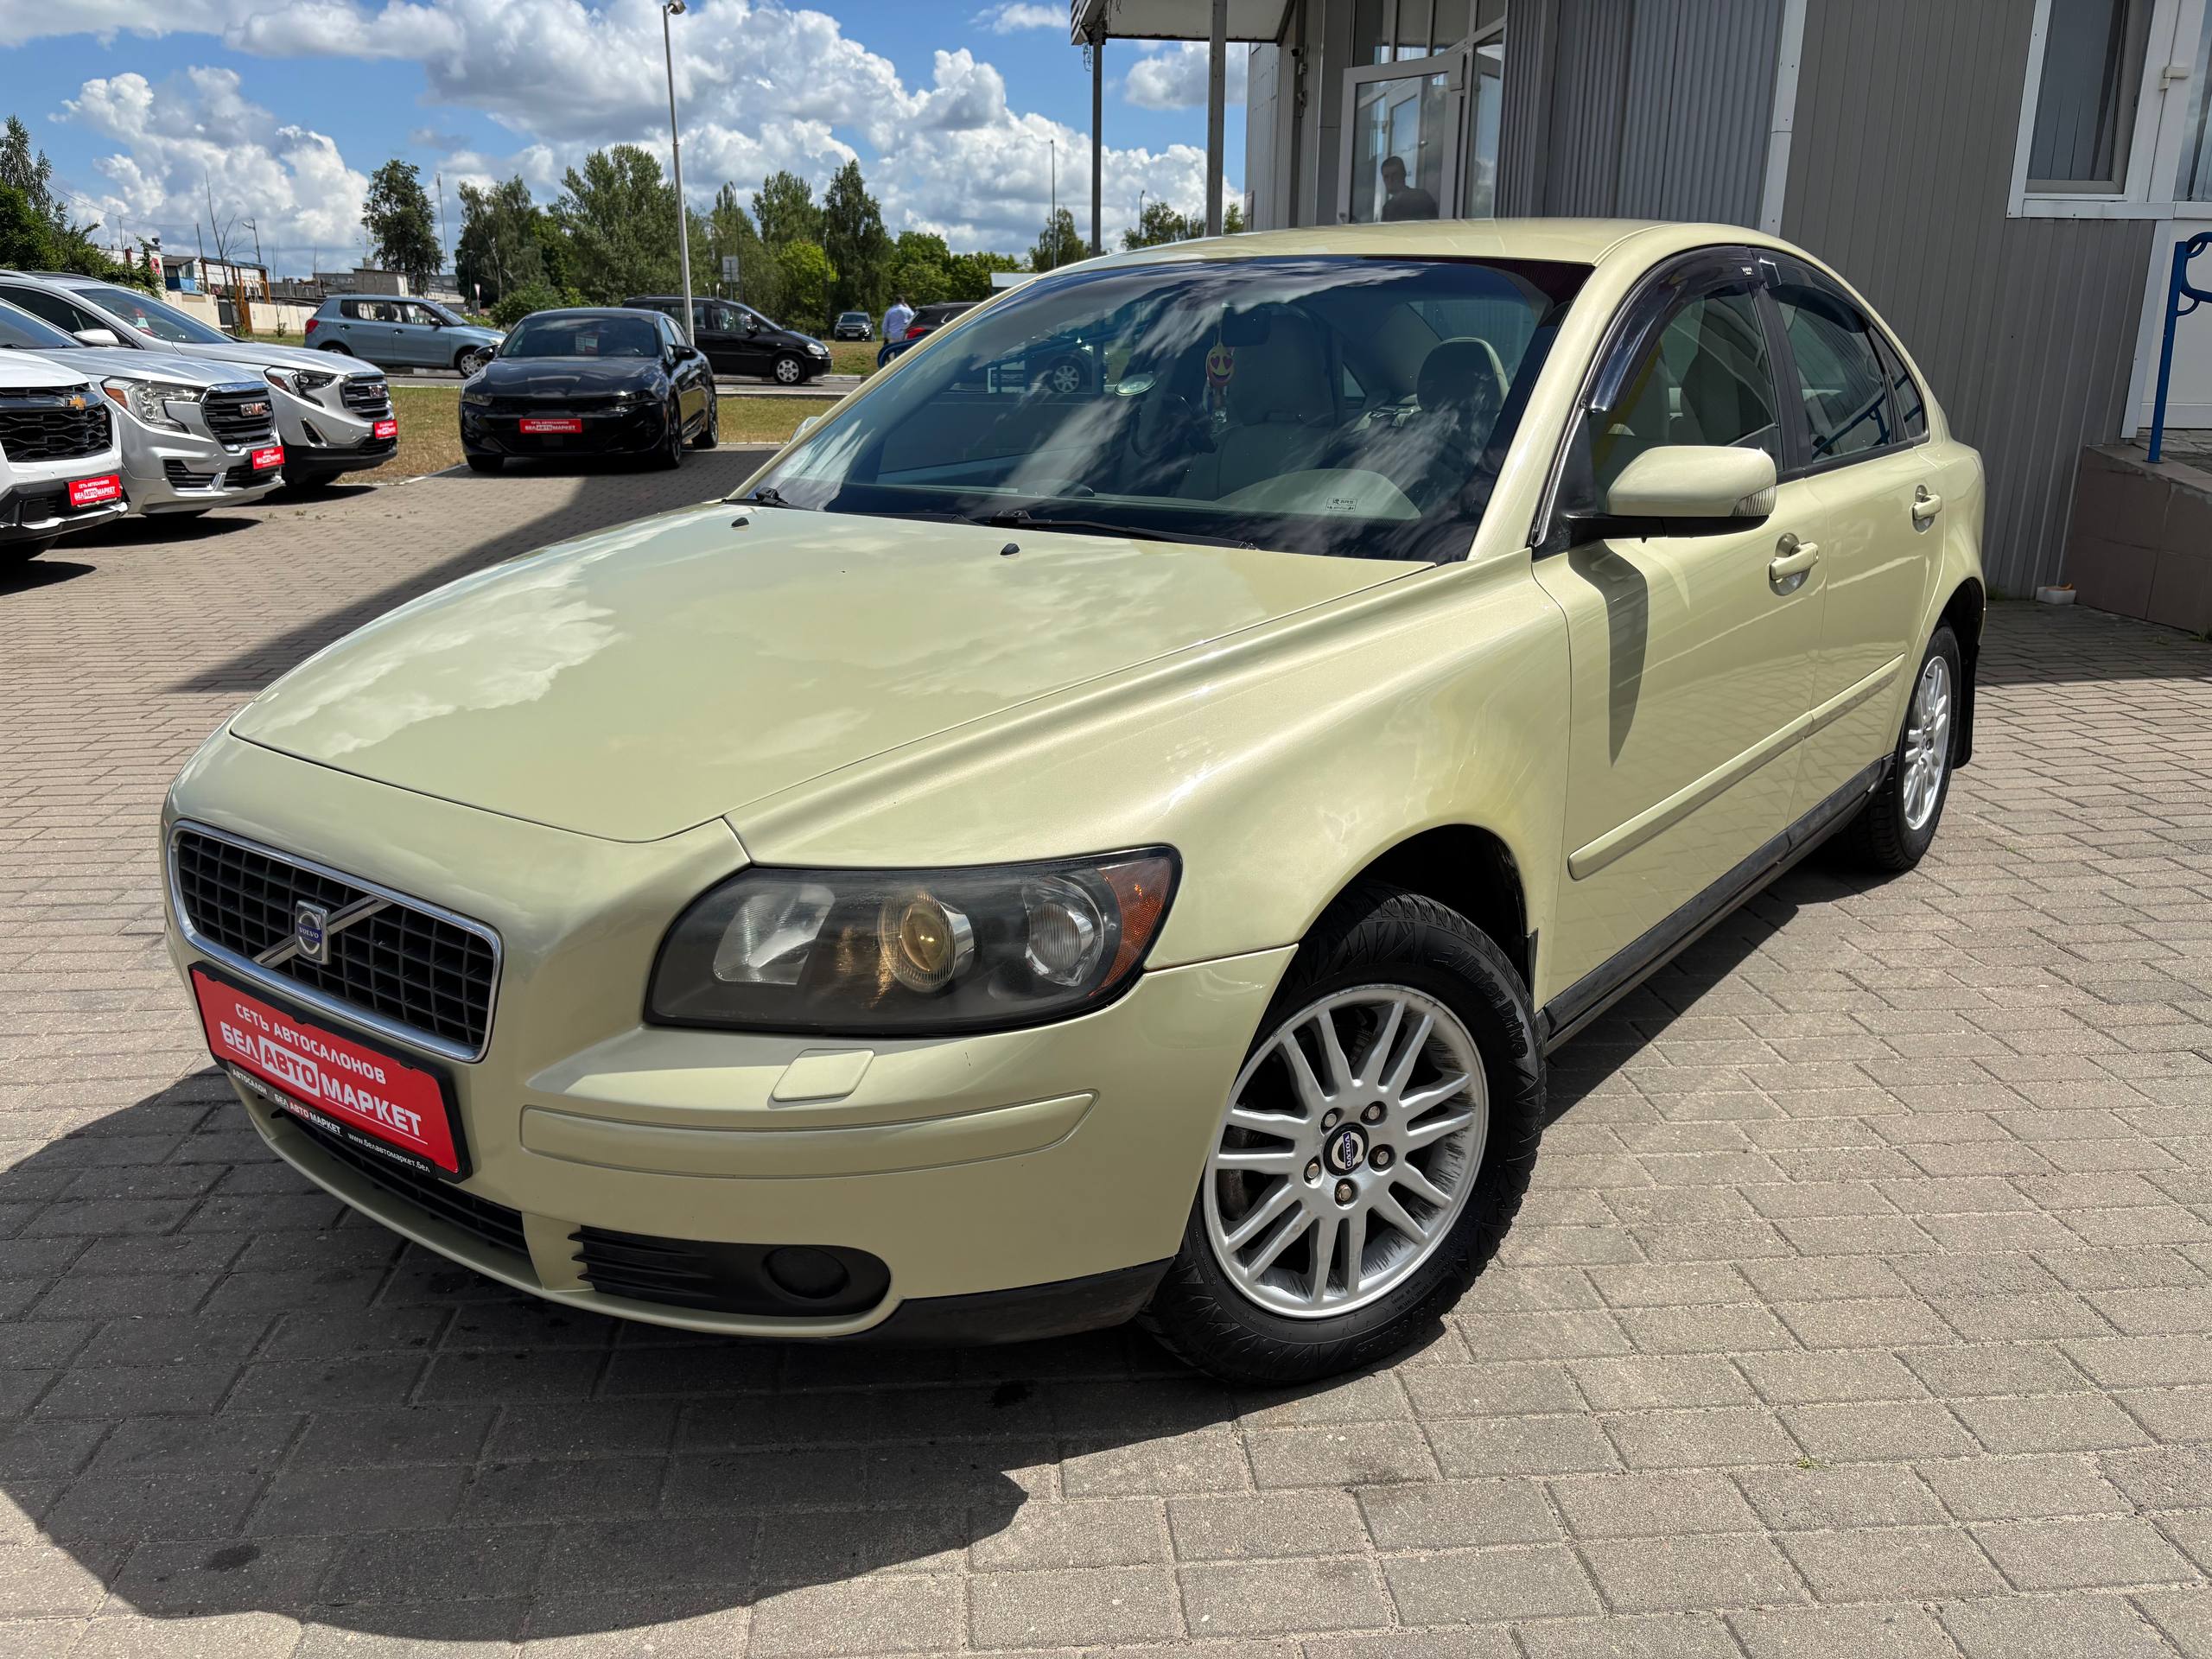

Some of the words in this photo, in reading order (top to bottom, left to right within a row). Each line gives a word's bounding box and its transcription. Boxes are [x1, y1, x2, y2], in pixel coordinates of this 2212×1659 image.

[299, 927, 319, 938] VOLVO
[235, 1002, 270, 1032] СЕТЬ
[273, 1022, 387, 1085] АВТОСАЛОНОВ
[232, 1069, 268, 1096] АВТОСАЛОН
[347, 1133, 430, 1173] www.белавтомаркет.бел
[1344, 1134, 1352, 1167] VOLVO
